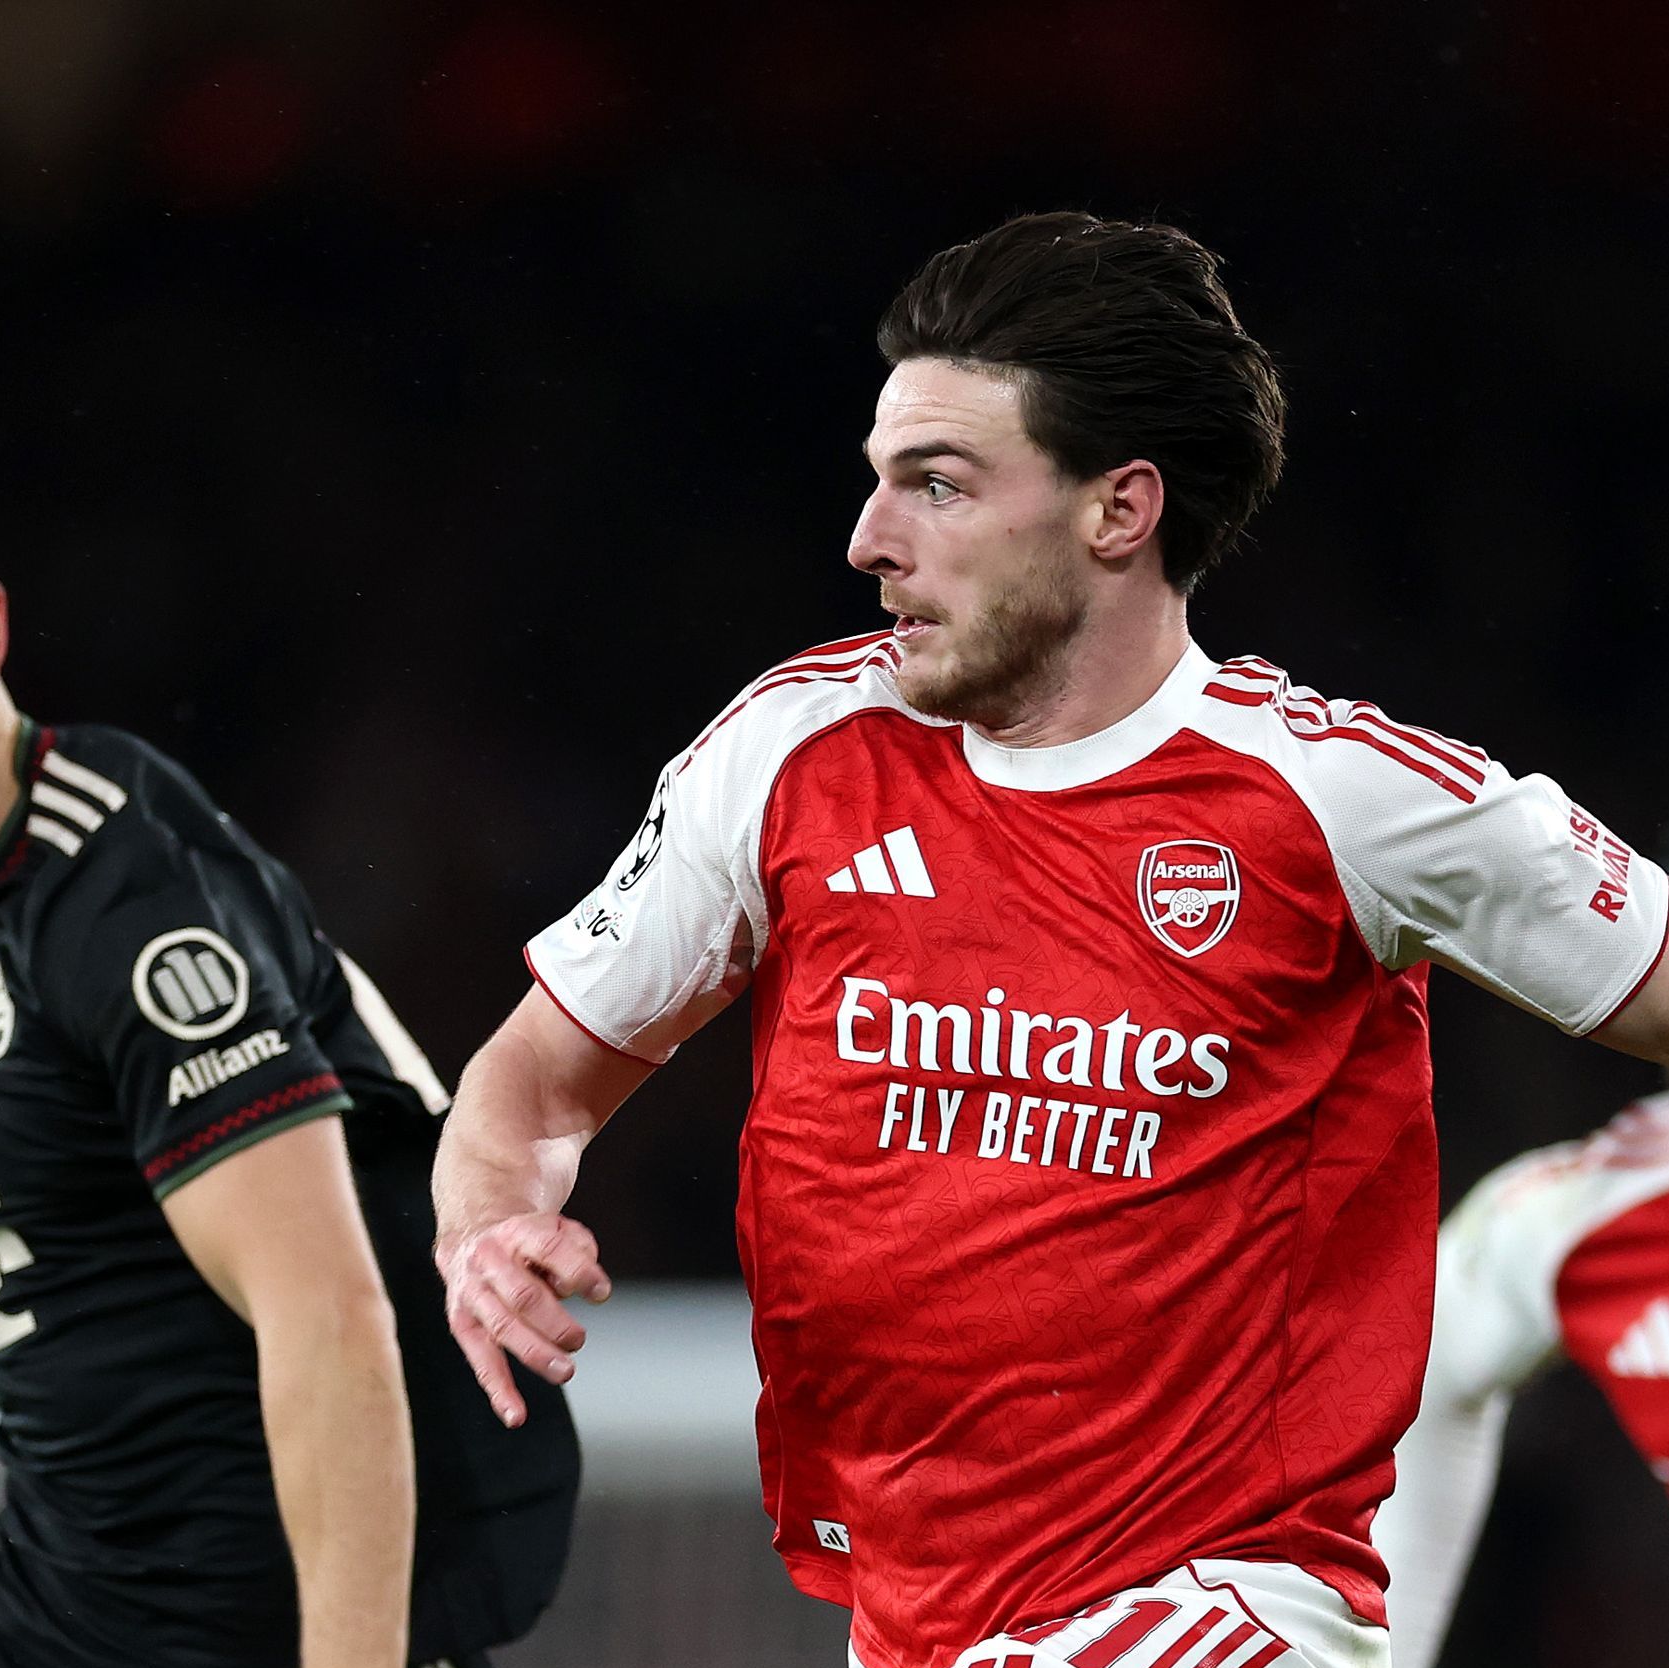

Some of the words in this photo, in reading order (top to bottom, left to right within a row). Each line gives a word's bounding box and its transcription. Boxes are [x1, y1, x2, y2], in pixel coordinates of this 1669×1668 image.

[1152, 860, 1226, 879] Arsenal
[168, 1028, 291, 1107] Allianz
[835, 975, 1231, 1099] Emirates
[877, 1081, 965, 1155] FLY
[977, 1090, 1162, 1180] BETTER
